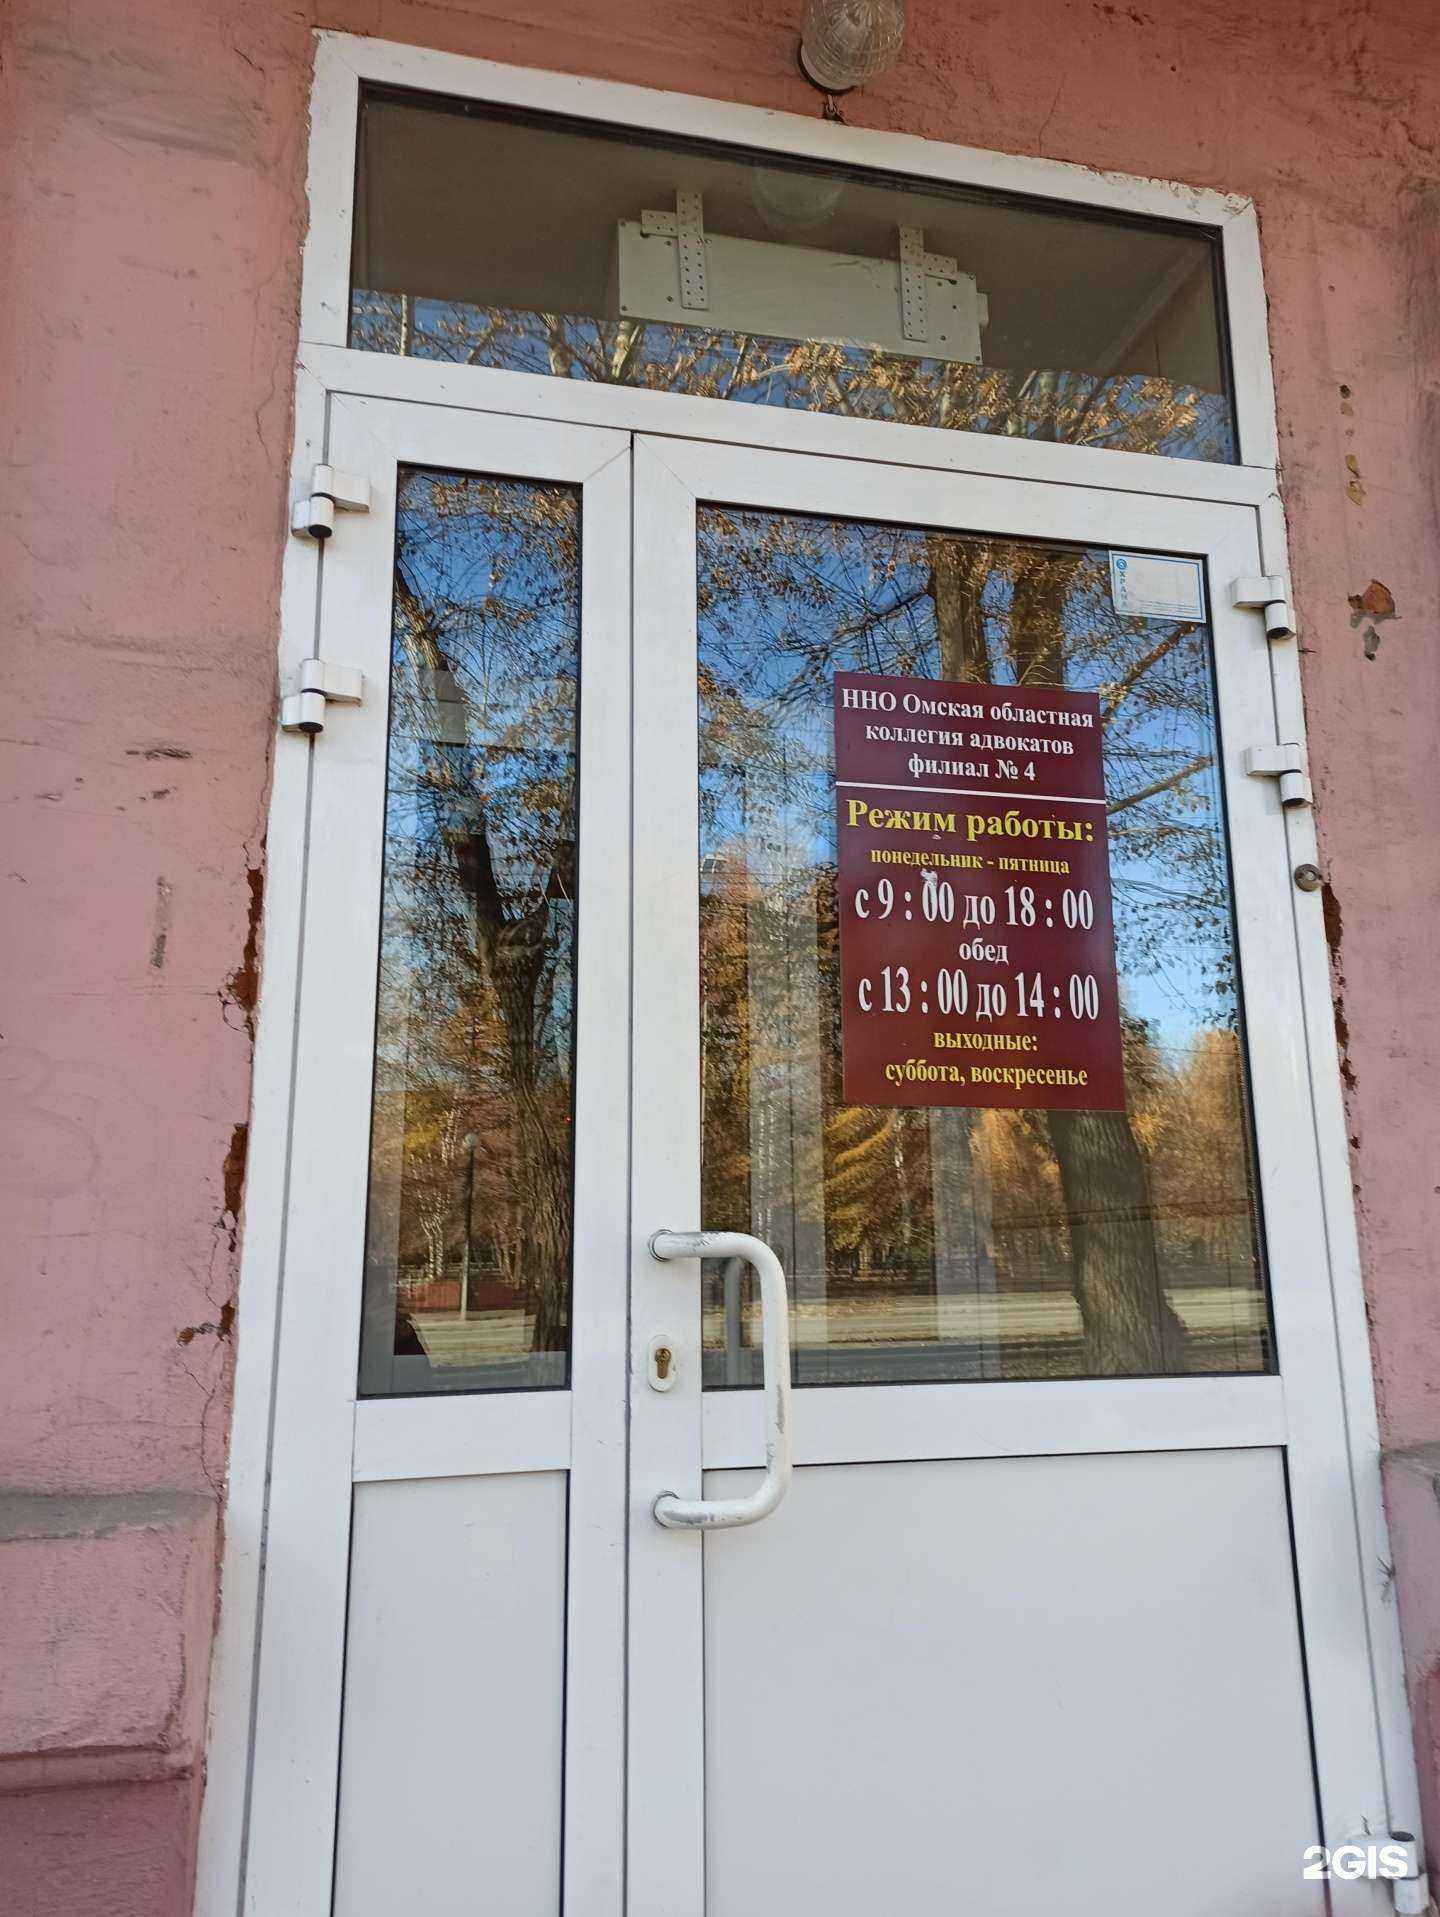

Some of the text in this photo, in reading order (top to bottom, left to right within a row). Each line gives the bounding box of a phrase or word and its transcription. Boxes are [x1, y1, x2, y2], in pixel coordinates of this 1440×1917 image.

[842, 688, 1093, 728] ННО Омская областная
[866, 725, 1074, 755] коллегия адвокатов
[908, 753, 989, 778] филиал
[846, 799, 1095, 842] Режим работы:
[871, 850, 983, 869] понедельник
[998, 855, 1070, 875] пятница
[855, 888, 869, 919] с
[963, 895, 996, 931] до
[959, 937, 1009, 965] обед
[858, 977, 872, 1012] с
[976, 983, 1007, 1022] до
[933, 1031, 1039, 1051] выходные:
[885, 1058, 1088, 1090] суббота, воскресенье
